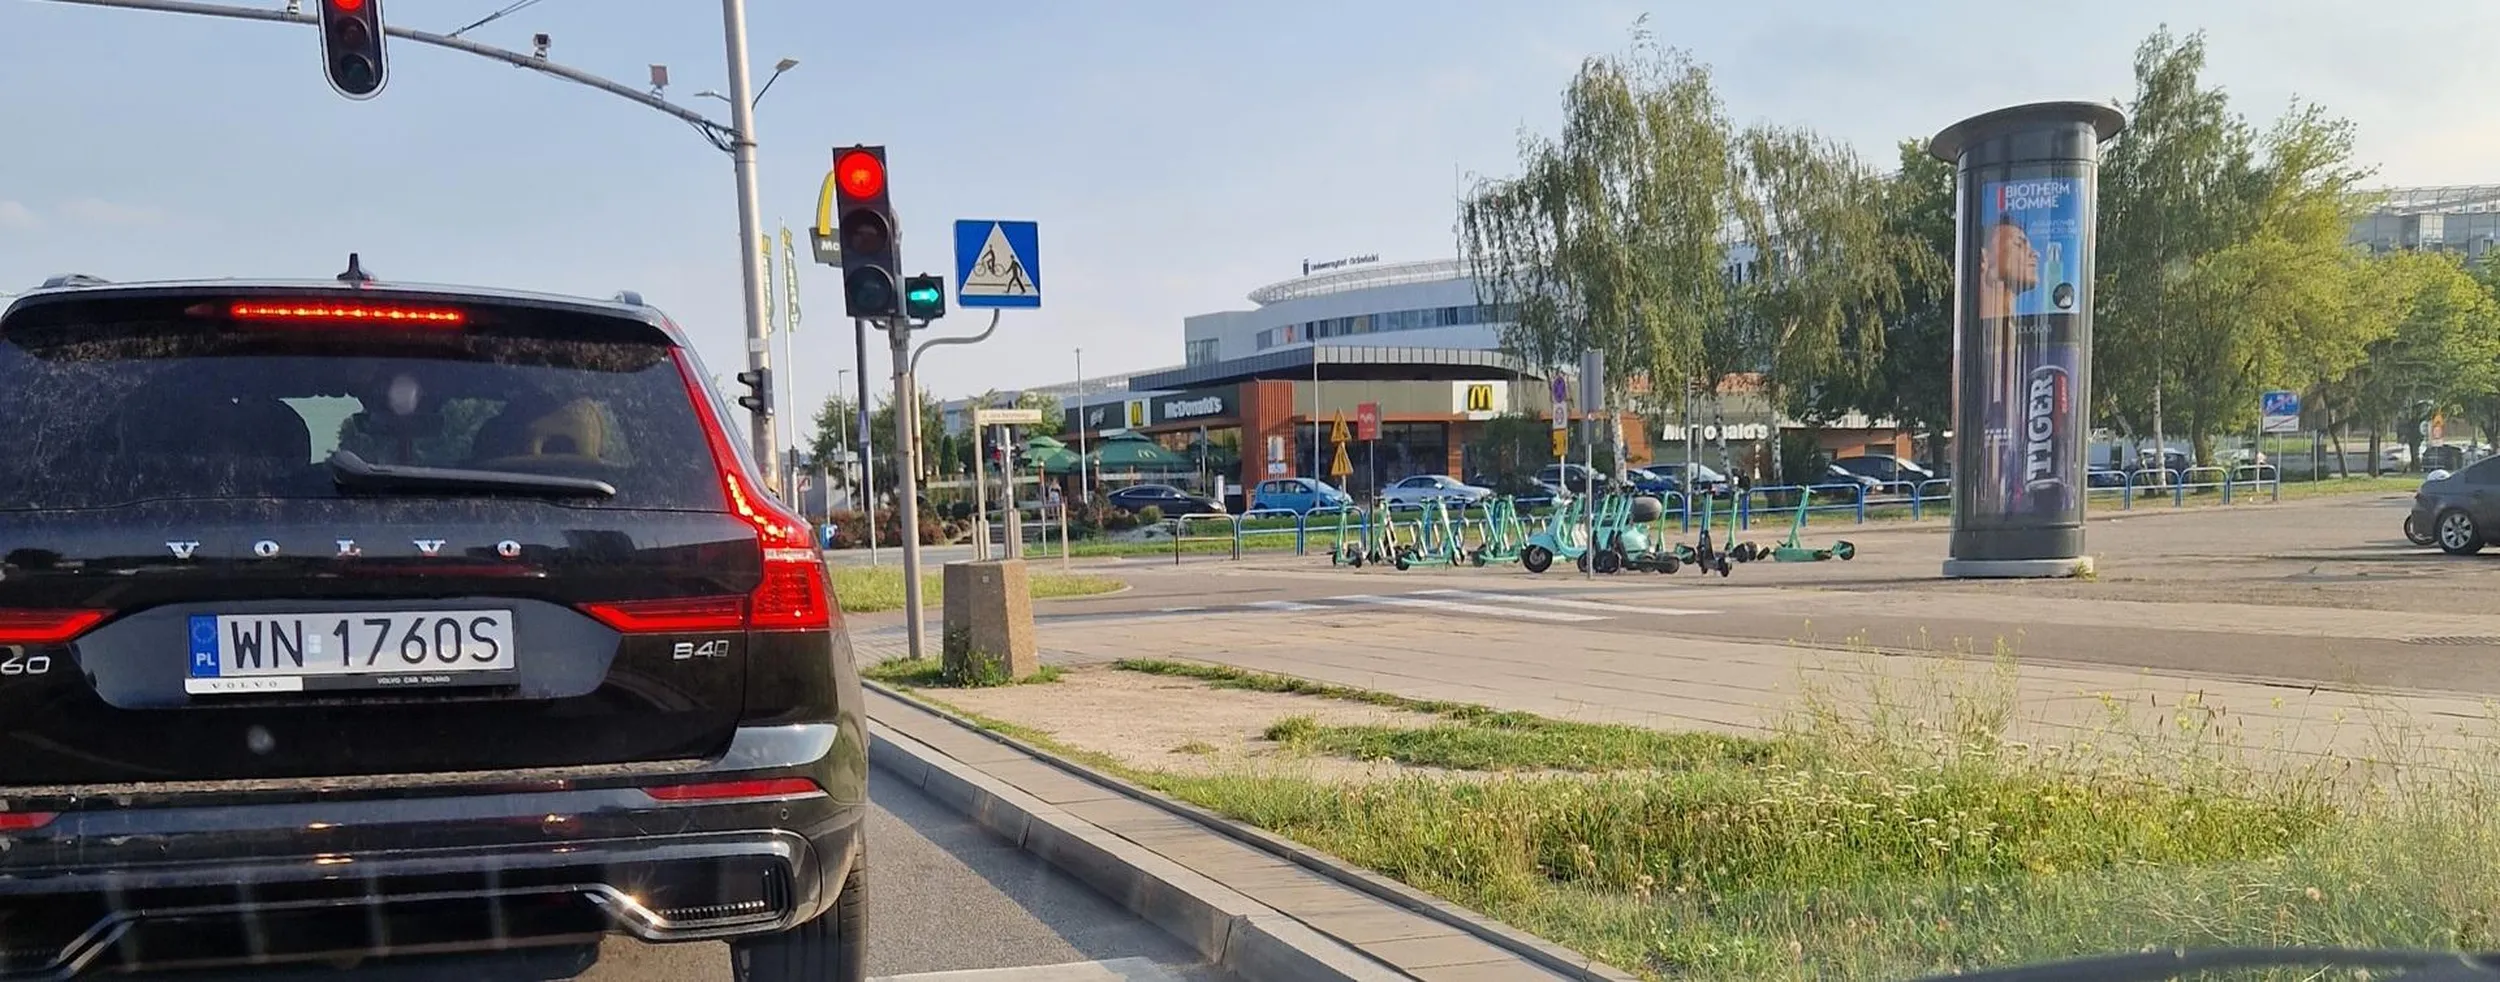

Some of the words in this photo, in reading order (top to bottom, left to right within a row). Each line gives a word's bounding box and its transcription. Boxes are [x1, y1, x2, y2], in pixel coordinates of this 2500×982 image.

[2005, 182, 2070, 198] BIOTHERM
[2005, 196, 2059, 211] HOMME
[1164, 396, 1223, 419] McDonald's
[2027, 374, 2054, 482] TIGER
[166, 540, 522, 560] VOLVO
[230, 619, 303, 669] WN
[333, 616, 499, 667] 1760S
[196, 652, 217, 667] PL
[210, 681, 277, 689] VOLVO
[376, 676, 401, 685] VOLVO
[421, 675, 451, 684] POLAND
